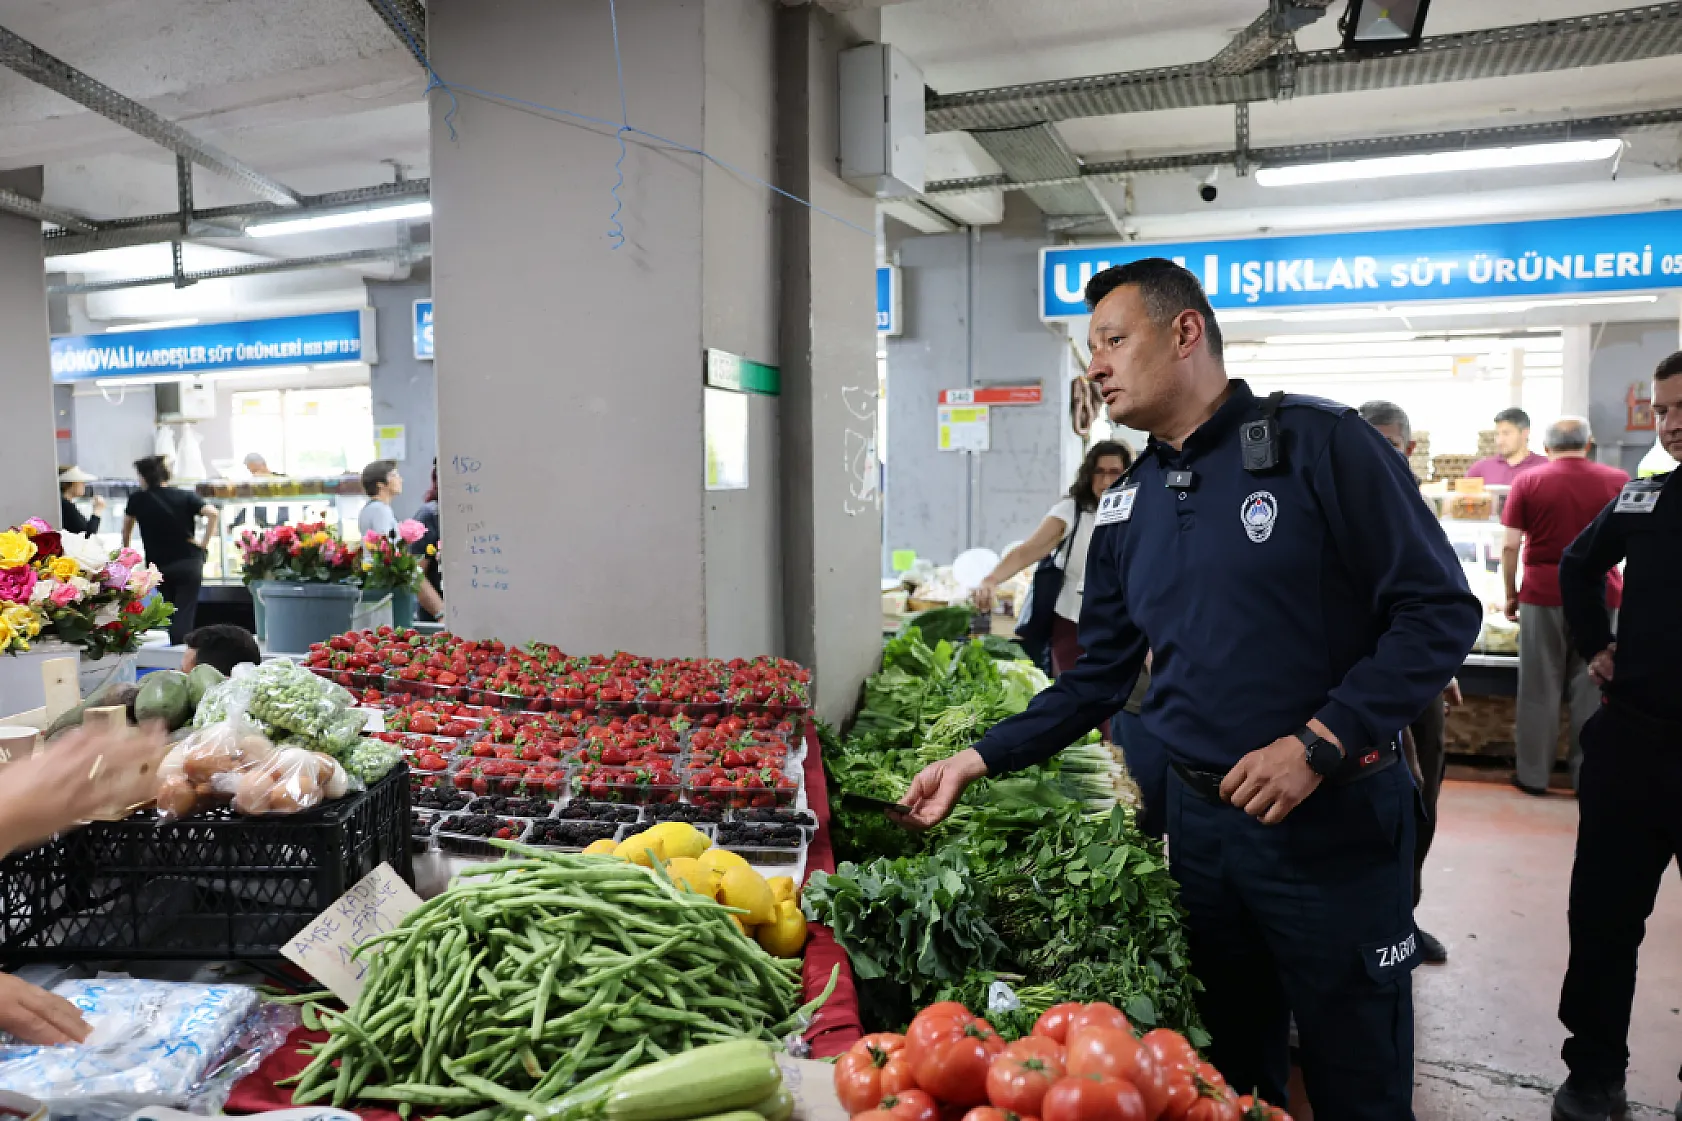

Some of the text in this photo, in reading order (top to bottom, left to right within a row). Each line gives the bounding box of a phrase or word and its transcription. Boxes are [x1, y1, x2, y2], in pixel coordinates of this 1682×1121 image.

[1230, 256, 1379, 302] IŞIKLAR
[1390, 257, 1459, 288] SÜT
[1468, 244, 1654, 283] ÜRÜNLERİ
[135, 345, 207, 369] KARDEŞLER
[208, 344, 233, 363] SÜT
[236, 338, 302, 360] ÜRÜNLERİ
[452, 454, 482, 474] 150
[294, 870, 382, 959] AYŞE KADIN
